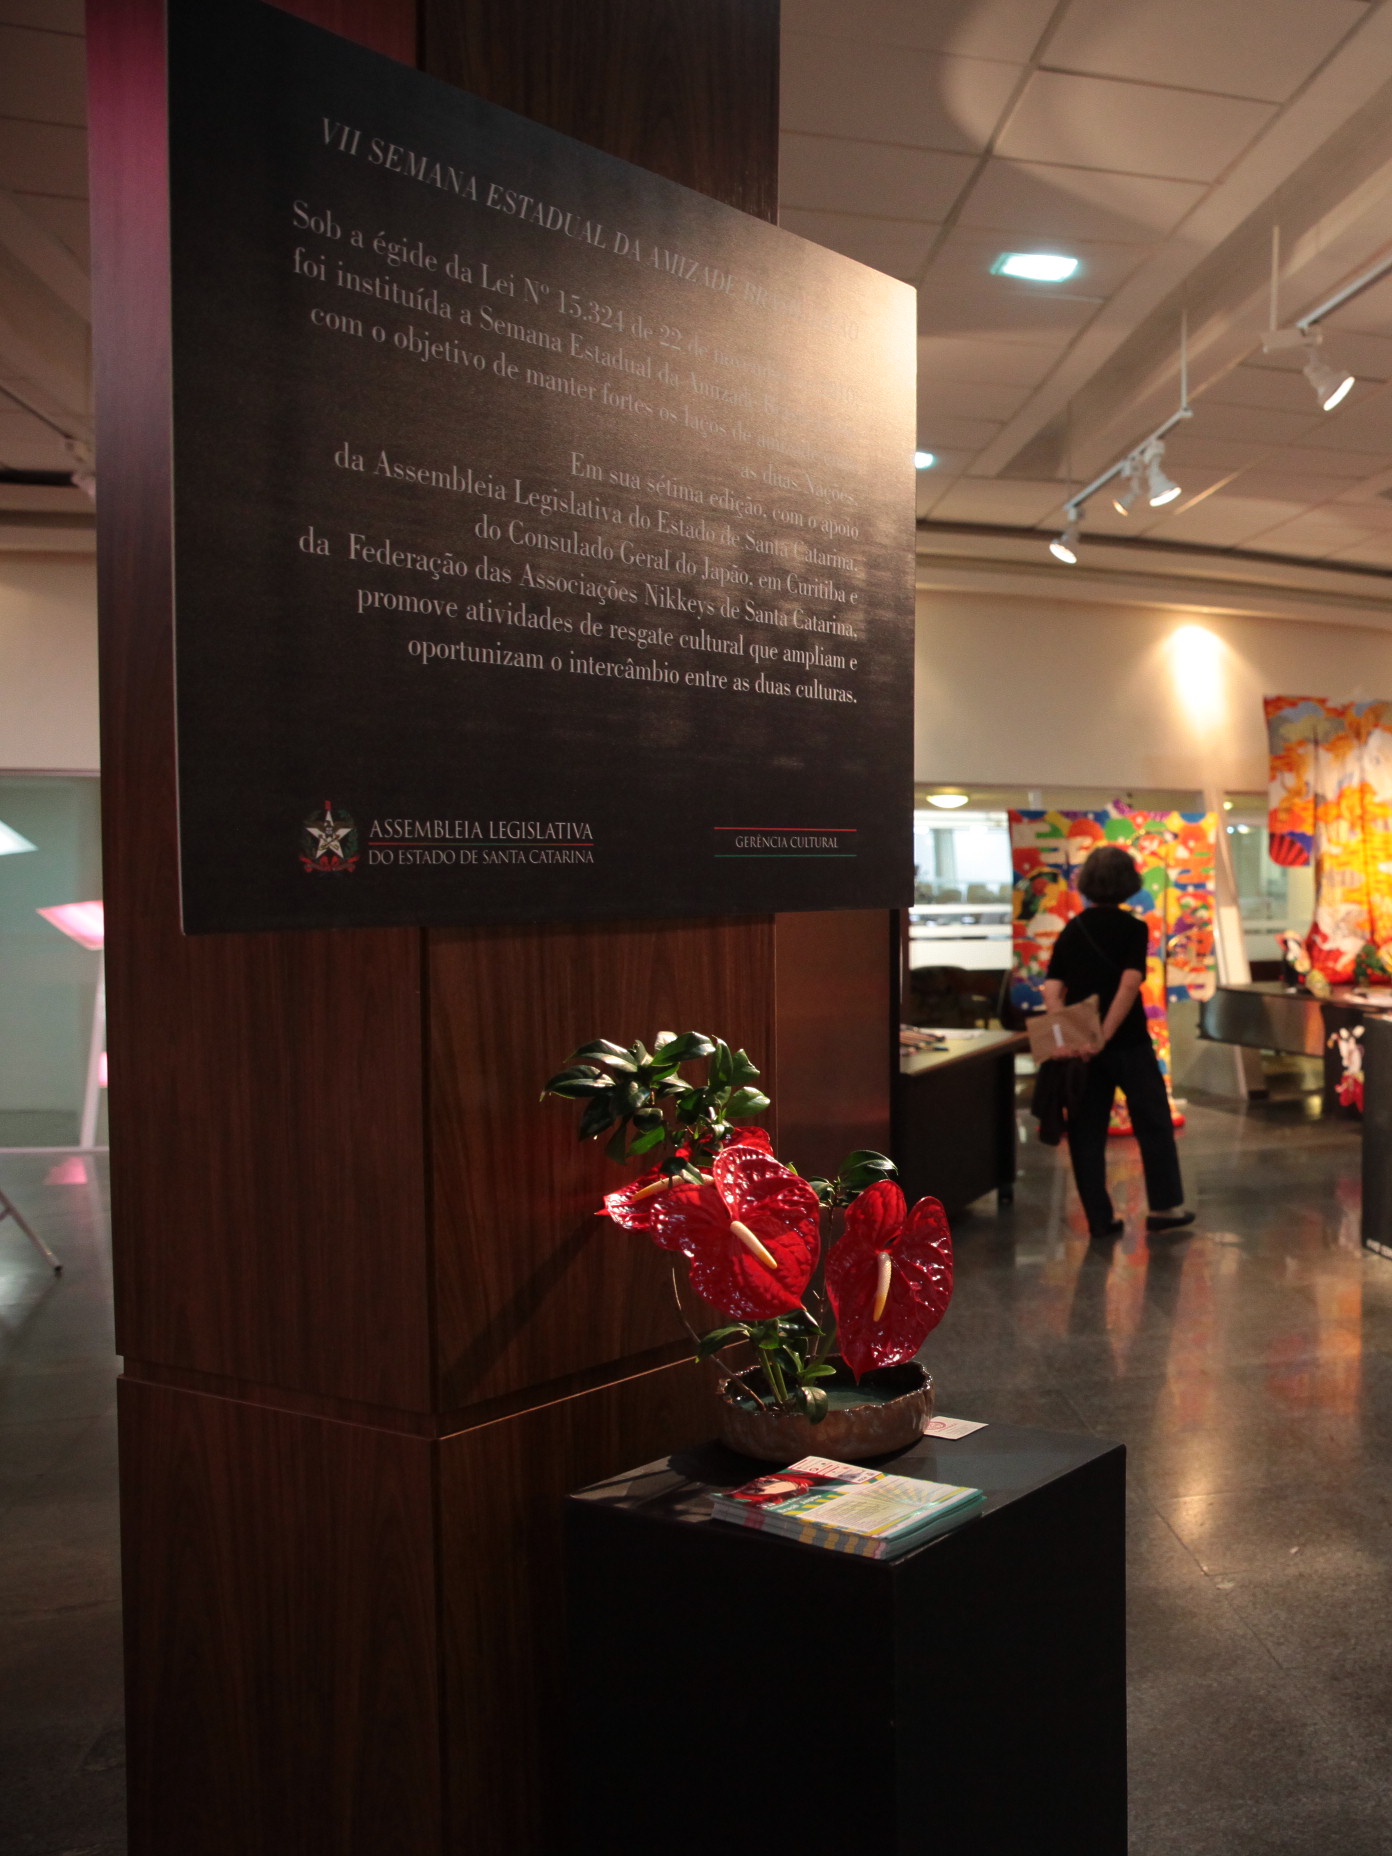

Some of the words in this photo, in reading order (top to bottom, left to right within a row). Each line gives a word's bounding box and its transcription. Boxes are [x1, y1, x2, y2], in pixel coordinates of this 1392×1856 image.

[322, 117, 360, 155] VII
[368, 138, 478, 201] SEMANA
[486, 183, 606, 249] ESTADUAL
[613, 232, 641, 261] DA
[649, 245, 736, 297] AMIZADE
[293, 200, 341, 240] Sob
[351, 230, 363, 248] a
[373, 231, 437, 271] égide
[446, 254, 472, 284] da
[482, 264, 514, 296] Lei
[559, 290, 624, 332] 15.324
[631, 316, 653, 340] de
[659, 325, 683, 350] 22
[688, 335, 708, 356] de
[293, 246, 326, 282] foi
[338, 261, 451, 319] instituída
[460, 307, 472, 326] a
[480, 305, 562, 352] Semana
[570, 333, 651, 379] Estadual
[658, 361, 679, 387] da
[310, 308, 363, 337] com
[372, 326, 386, 343] o
[394, 326, 486, 371] objetivo
[492, 351, 519, 380] de
[526, 367, 597, 401] manter
[602, 382, 653, 413] fortes
[659, 407, 678, 420] os
[684, 404, 727, 439] laços
[334, 442, 364, 471] da
[373, 449, 506, 501] Assembleia
[513, 478, 622, 525] Legislativa
[629, 505, 651, 529] do
[656, 509, 716, 541] Estado
[720, 525, 740, 547] de
[745, 530, 789, 557] Santa
[570, 452, 602, 481] Em
[609, 468, 641, 490] sua
[648, 474, 703, 504] sétima
[772, 507, 803, 527] com
[808, 516, 817, 528] o
[821, 519, 859, 541] apoio
[741, 463, 757, 480] as
[763, 462, 798, 489] duas
[299, 526, 330, 556] da
[348, 532, 468, 580] Federação
[475, 555, 512, 584] das
[520, 562, 638, 605] Associações
[645, 582, 715, 619] Nikkeys
[720, 597, 740, 619] de
[745, 599, 788, 627] Santa
[474, 513, 501, 541] do
[508, 519, 614, 560] Consulado
[620, 539, 671, 571] Geral
[676, 552, 697, 575] do
[758, 574, 782, 591] em
[786, 572, 846, 603] Curitiba
[850, 592, 858, 605] e
[357, 588, 458, 619] promove
[465, 599, 573, 633] atividades
[579, 612, 603, 637] de
[609, 622, 674, 650] resgate
[679, 628, 744, 656] cultural
[749, 643, 779, 664] que
[783, 644, 846, 670] ampliam
[850, 657, 858, 671] e
[407, 638, 545, 670] oportunizam
[551, 656, 562, 672] o
[569, 650, 680, 685] intercâmbio
[685, 669, 728, 689] entre
[732, 676, 750, 691] as
[755, 672, 791, 696] duas
[796, 679, 858, 704] culturas.
[368, 849, 394, 865] DO
[399, 849, 456, 865] ESTADO
[460, 849, 478, 864] DE
[482, 849, 527, 864] SANTA
[529, 849, 594, 864] CATARINA
[369, 819, 483, 838] ASSEMBLEIA
[489, 821, 594, 840] LEGISLATIVA
[735, 834, 788, 848] GERÊNCIA
[790, 836, 838, 848] CULTURAL
